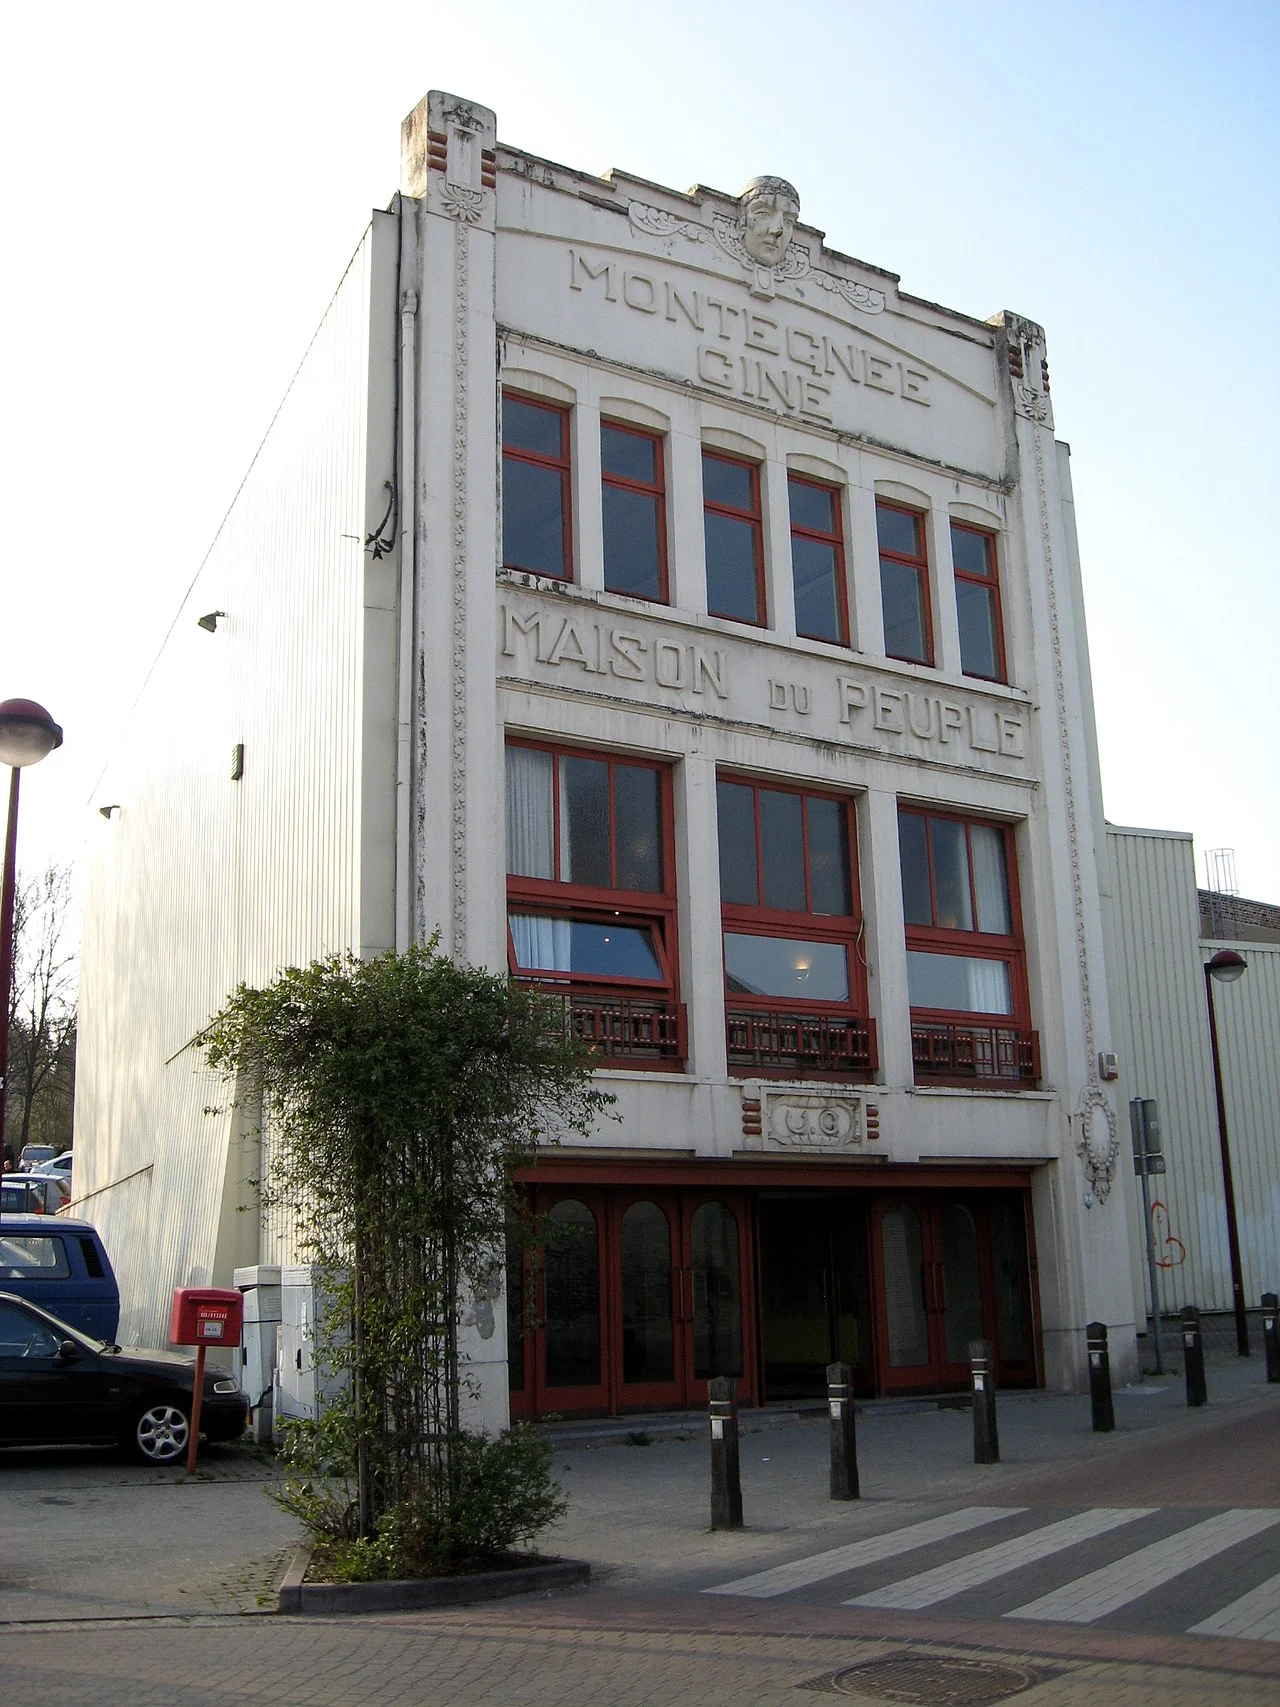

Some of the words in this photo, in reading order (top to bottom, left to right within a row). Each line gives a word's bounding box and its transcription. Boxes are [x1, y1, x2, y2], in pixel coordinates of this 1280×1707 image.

[568, 248, 932, 408] MONTEGNEE
[697, 343, 833, 425] CINE
[501, 604, 728, 699] MAISON
[767, 678, 812, 715] DU
[837, 675, 1025, 759] PEUPLE
